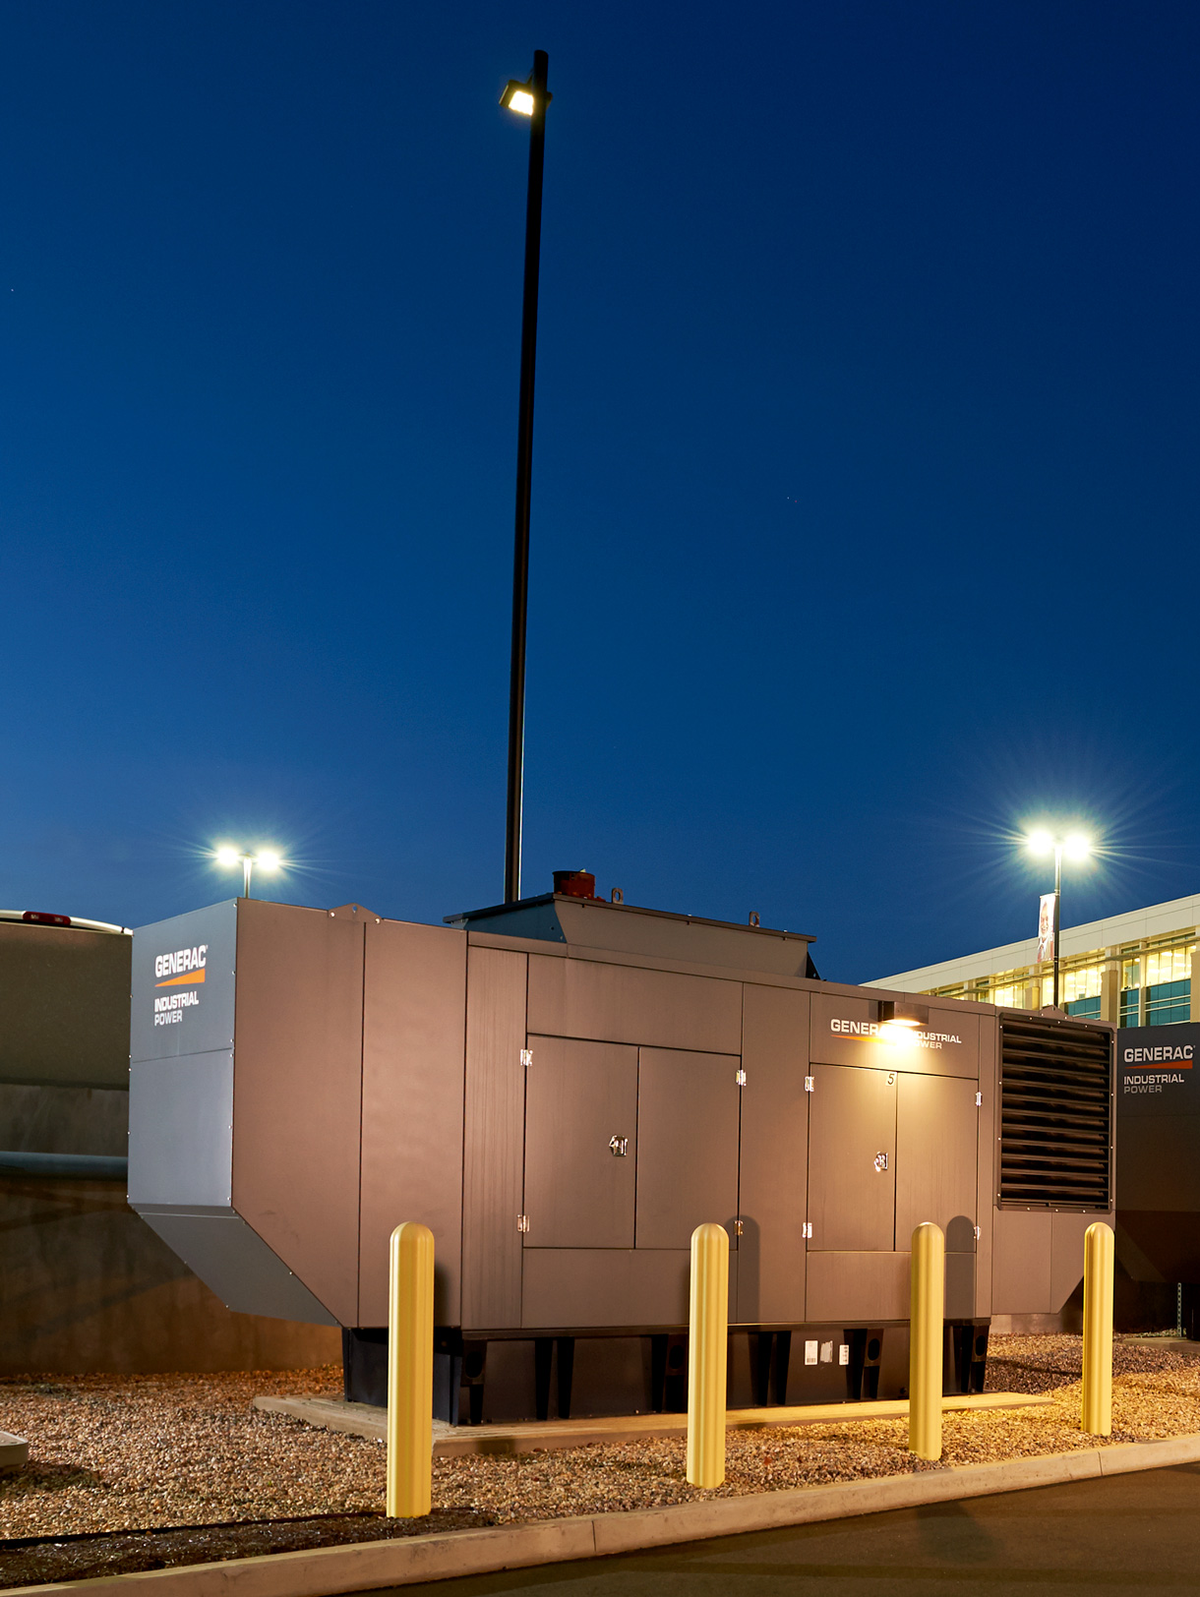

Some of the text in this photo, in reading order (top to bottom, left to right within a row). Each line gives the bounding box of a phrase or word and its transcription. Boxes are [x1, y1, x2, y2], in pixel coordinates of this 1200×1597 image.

[155, 944, 207, 978] GENERAC
[154, 991, 199, 1013] INDUSTRIAL
[154, 1009, 183, 1027] POWER
[830, 1018, 890, 1040] GENER
[911, 1039, 943, 1049] OWER
[1124, 1044, 1194, 1062] GENERAC
[887, 1073, 895, 1085] 5
[1123, 1074, 1185, 1085] INDUSTRIAL
[1123, 1085, 1163, 1094] POWER
